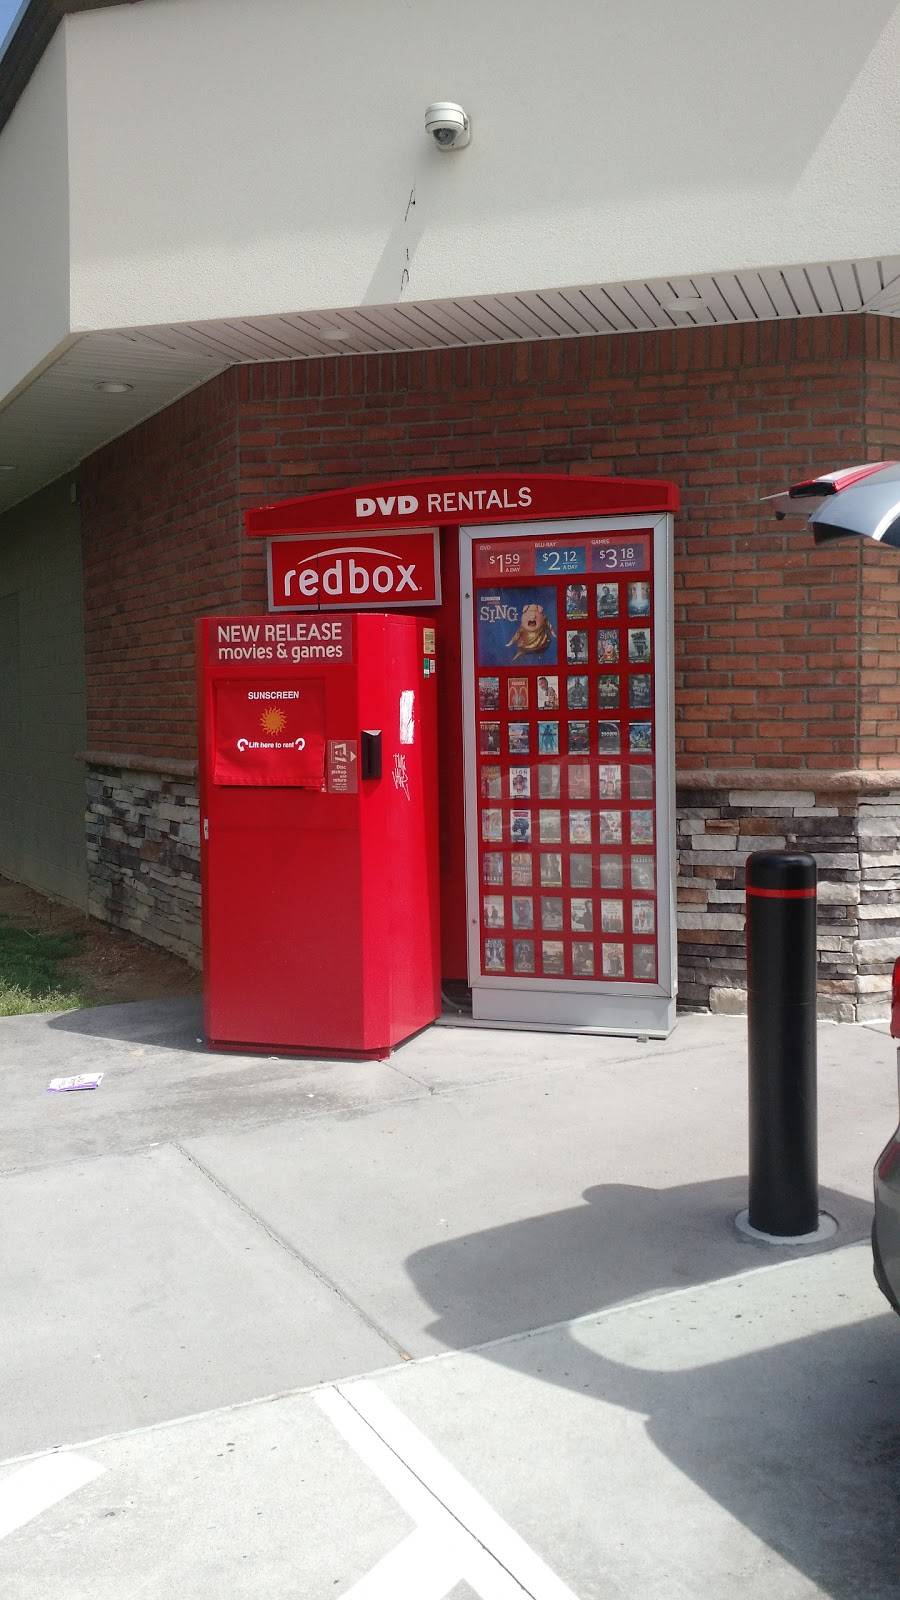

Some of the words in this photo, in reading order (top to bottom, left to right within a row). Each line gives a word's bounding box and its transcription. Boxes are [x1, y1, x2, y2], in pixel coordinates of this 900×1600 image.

[355, 495, 419, 518] DVD
[427, 486, 533, 513] RENTALS
[284, 559, 420, 597] redbox
[217, 625, 260, 643] NEW
[264, 622, 342, 642] RELEASE
[218, 643, 273, 660] movies
[276, 643, 288, 659] &
[291, 644, 343, 663] games
[247, 690, 300, 700] SUNSCREEN
